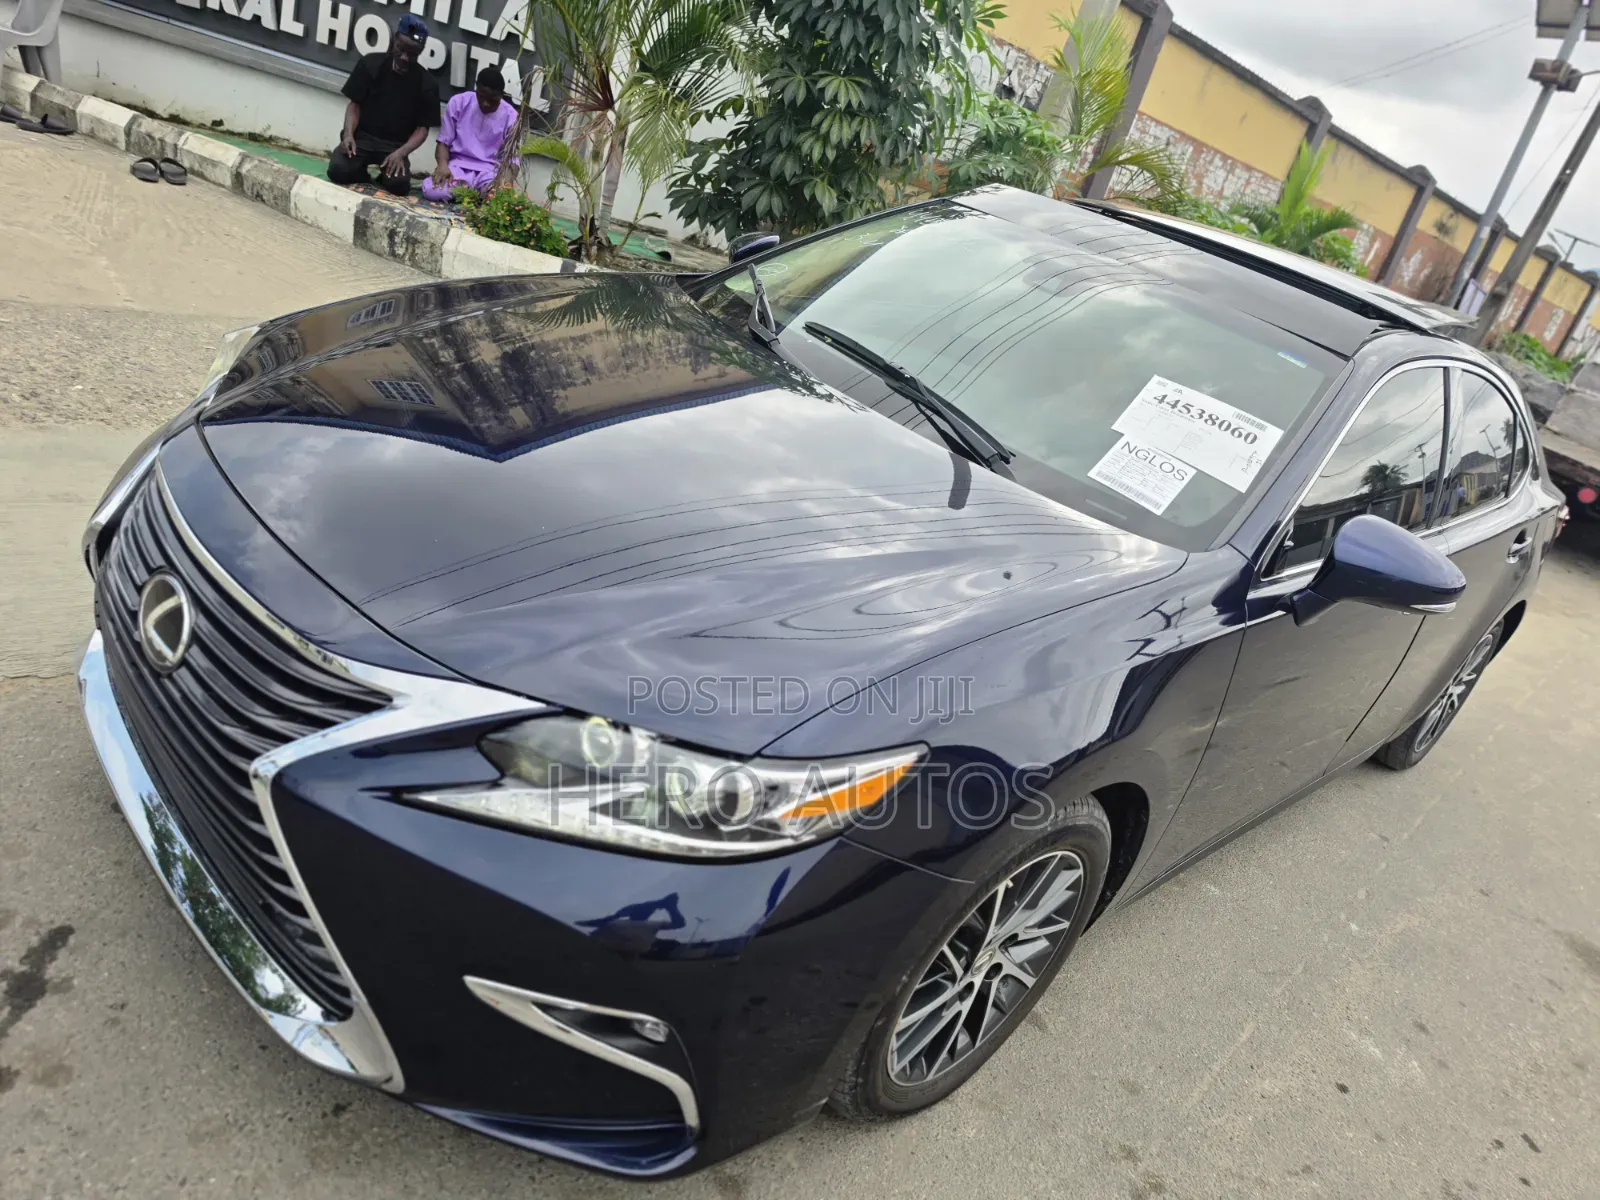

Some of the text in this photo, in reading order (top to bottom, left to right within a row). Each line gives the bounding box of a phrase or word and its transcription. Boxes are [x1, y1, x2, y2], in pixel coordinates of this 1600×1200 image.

[315, 0, 550, 113] HOPITAL
[1153, 394, 1258, 445] 44538060
[1120, 441, 1188, 482] NGLOS
